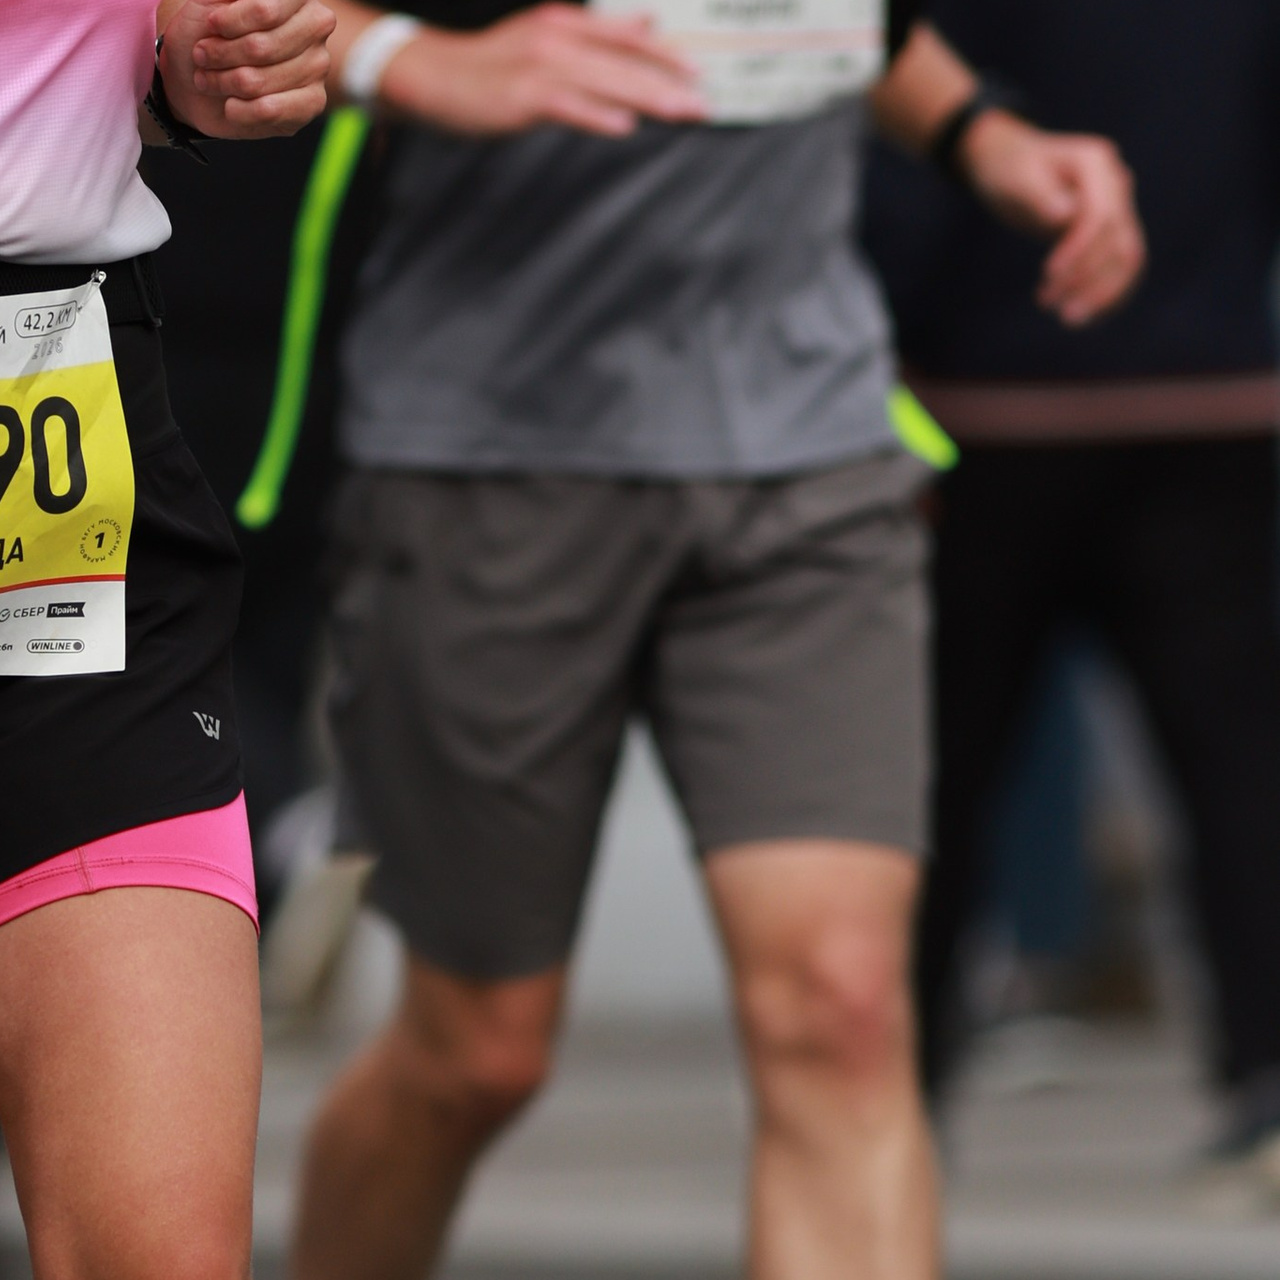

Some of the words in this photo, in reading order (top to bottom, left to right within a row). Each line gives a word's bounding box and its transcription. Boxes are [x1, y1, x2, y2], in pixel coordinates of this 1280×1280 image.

[23, 311, 55, 332] 42,2
[95, 531, 106, 549] 1
[13, 606, 45, 619] СБЕР
[50, 606, 79, 615] Прайм
[31, 641, 72, 651] WINLINE
